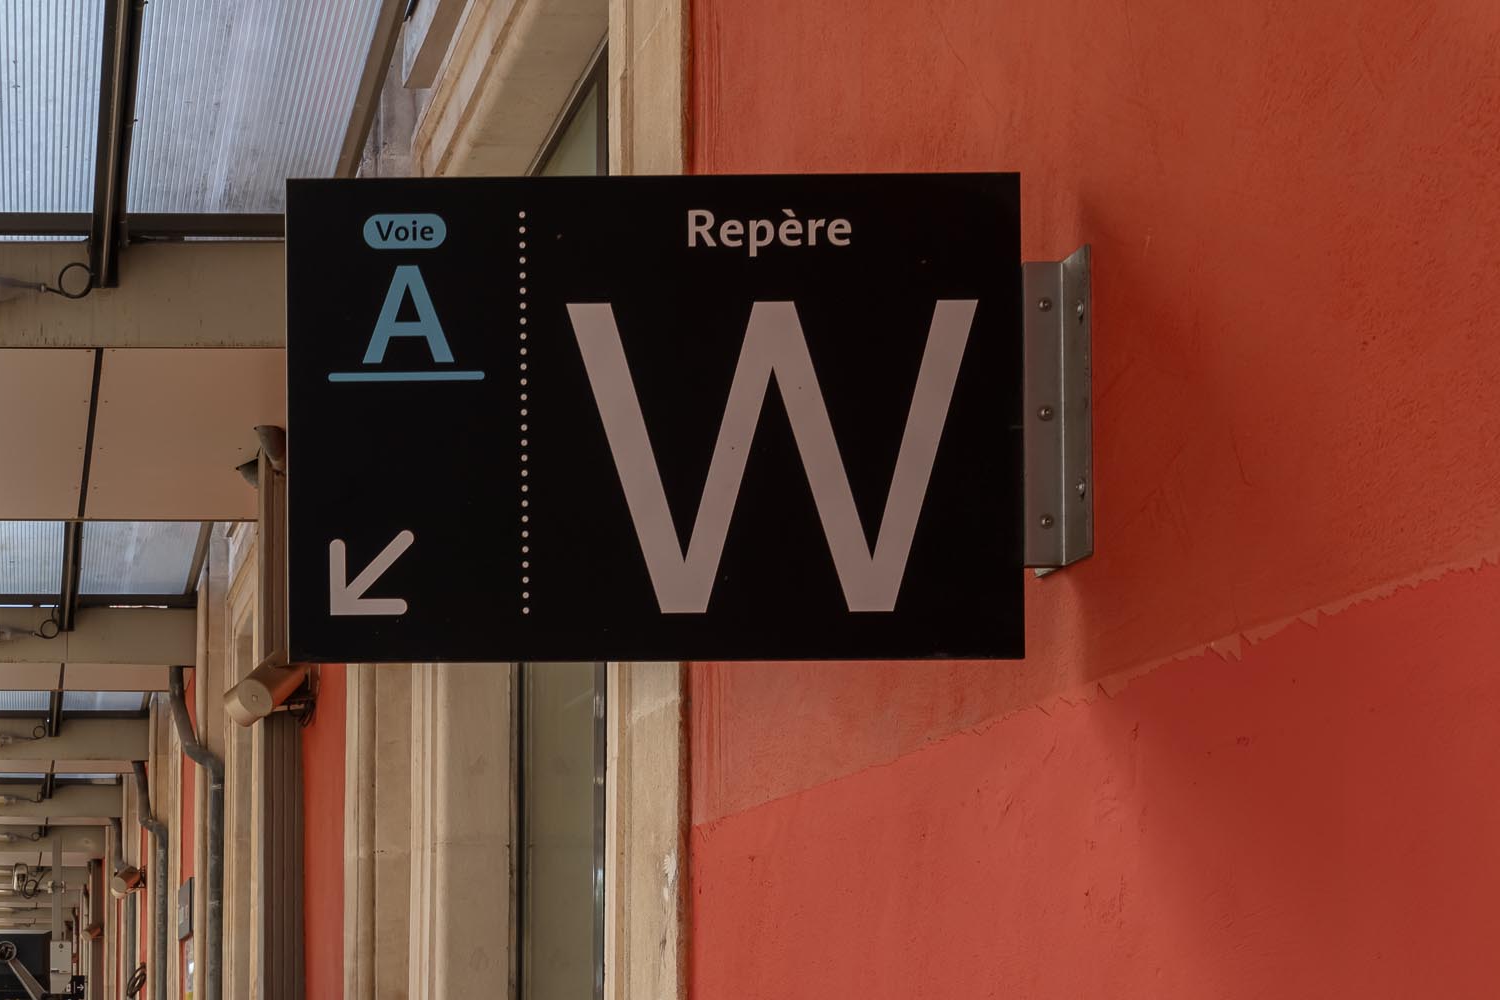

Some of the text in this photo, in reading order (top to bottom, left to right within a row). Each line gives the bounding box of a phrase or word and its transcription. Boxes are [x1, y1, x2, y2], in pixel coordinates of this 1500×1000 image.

[375, 220, 434, 241] Voie
[687, 209, 852, 256] Repère
[362, 265, 455, 363] A
[565, 299, 979, 614] W
